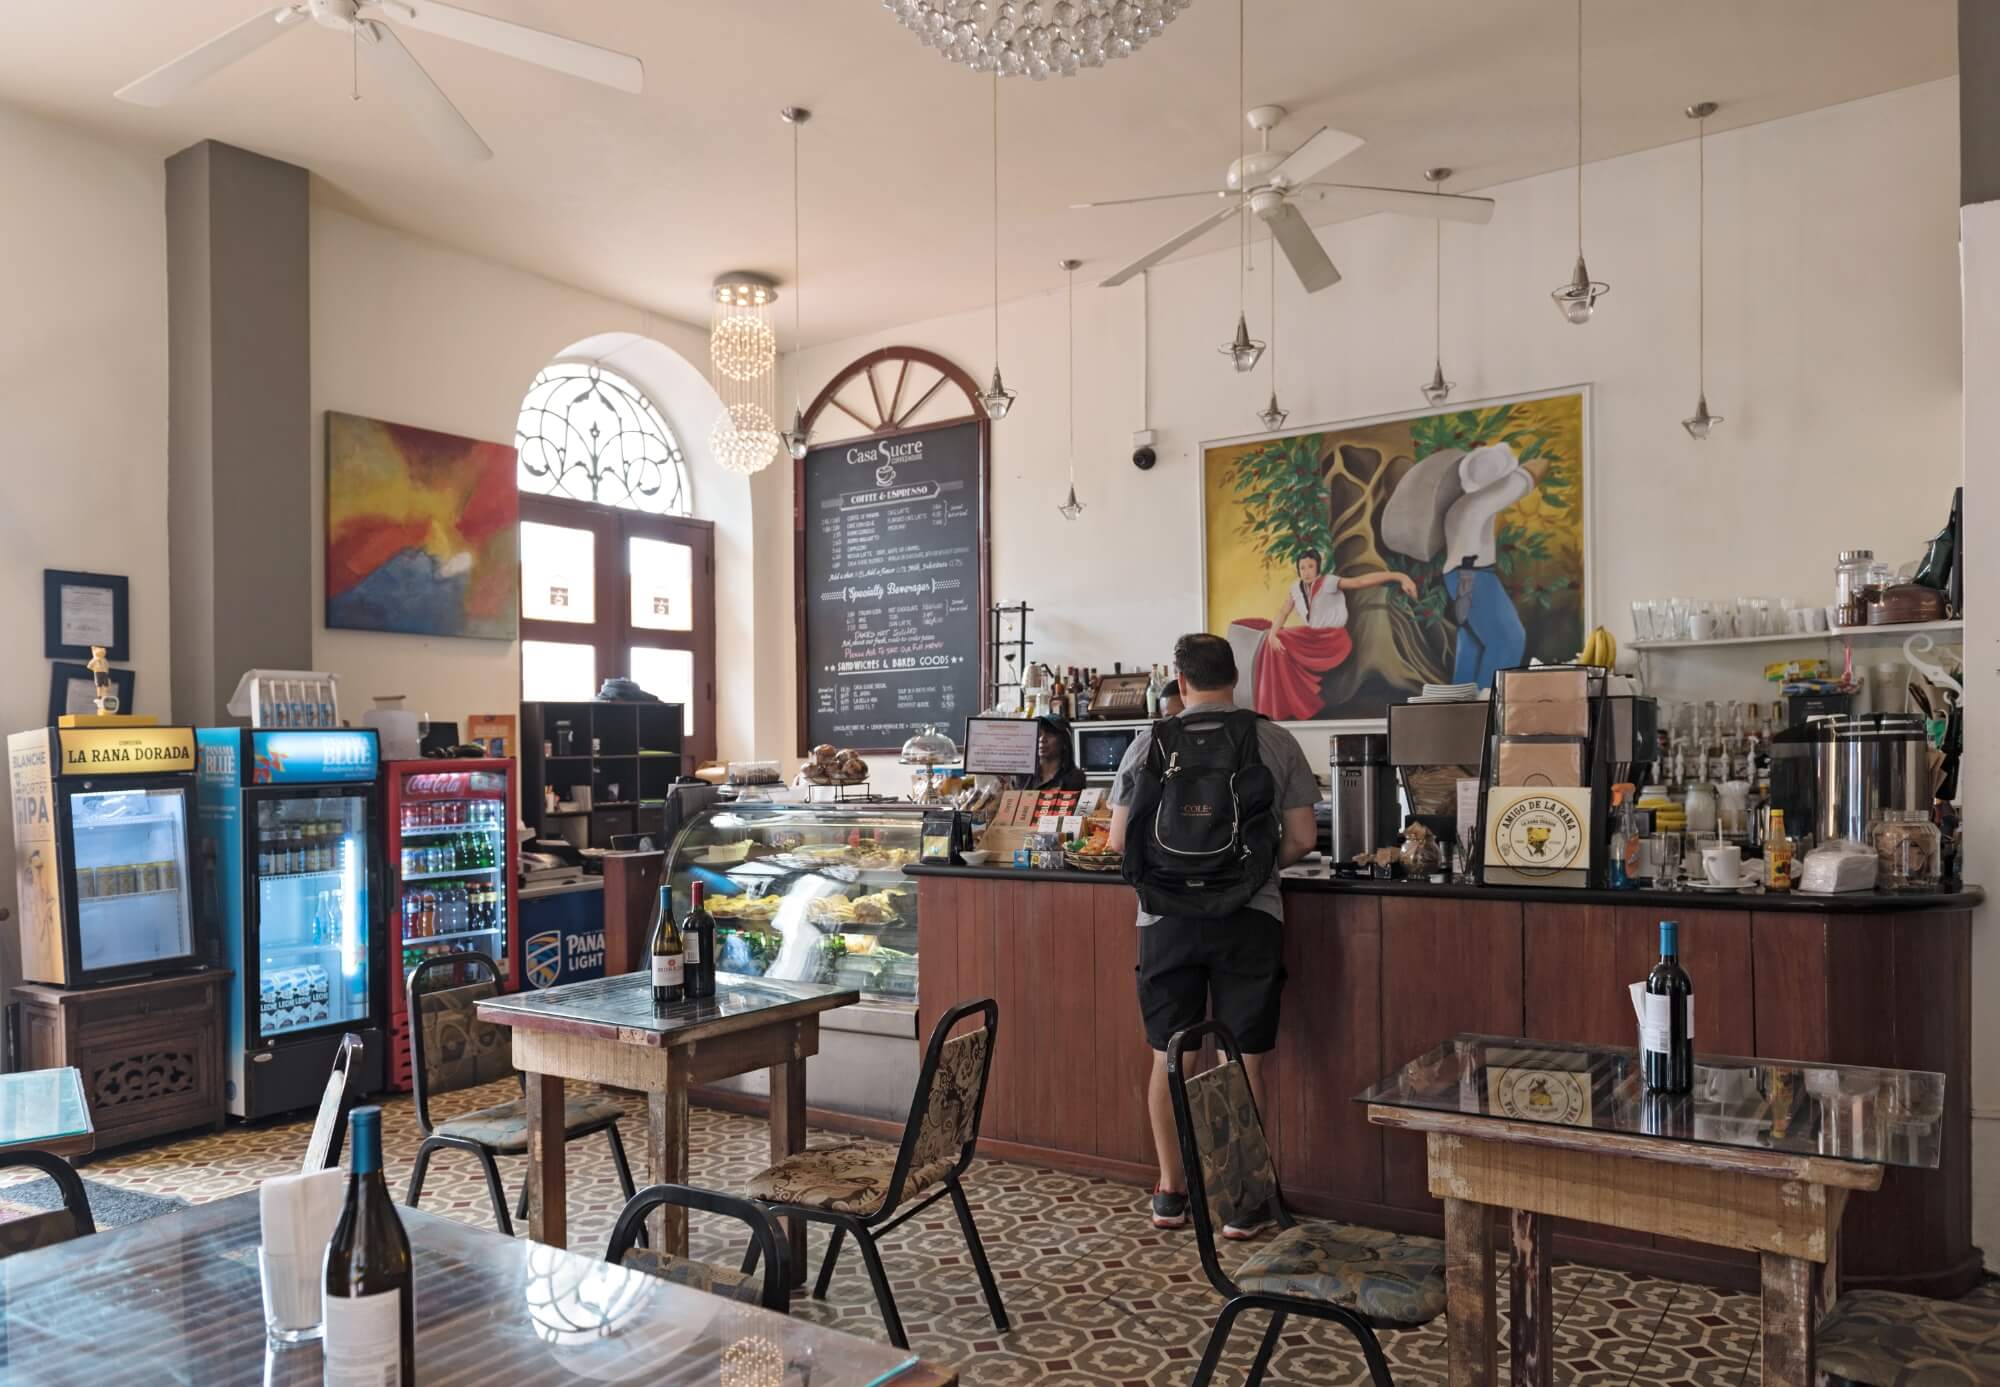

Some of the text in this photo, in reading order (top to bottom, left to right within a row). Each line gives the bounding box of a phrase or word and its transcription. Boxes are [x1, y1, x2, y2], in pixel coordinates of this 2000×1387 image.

[847, 448, 877, 465] Casa
[879, 440, 923, 466] Sucre
[851, 486, 928, 504] COFFEE & ESPRESSO
[887, 582, 930, 596] Beverages
[838, 655, 949, 671] SANDWICHES & BAKED GOODS
[13, 752, 46, 768] BLANCHE
[68, 746, 190, 764] LA RANA DORADA
[206, 755, 236, 774] BLUE
[24, 797, 49, 824] IPA
[1502, 801, 1577, 831] AMIGO DE LA RANA
[566, 933, 605, 955] PANA
[569, 953, 603, 971] LIGHT
